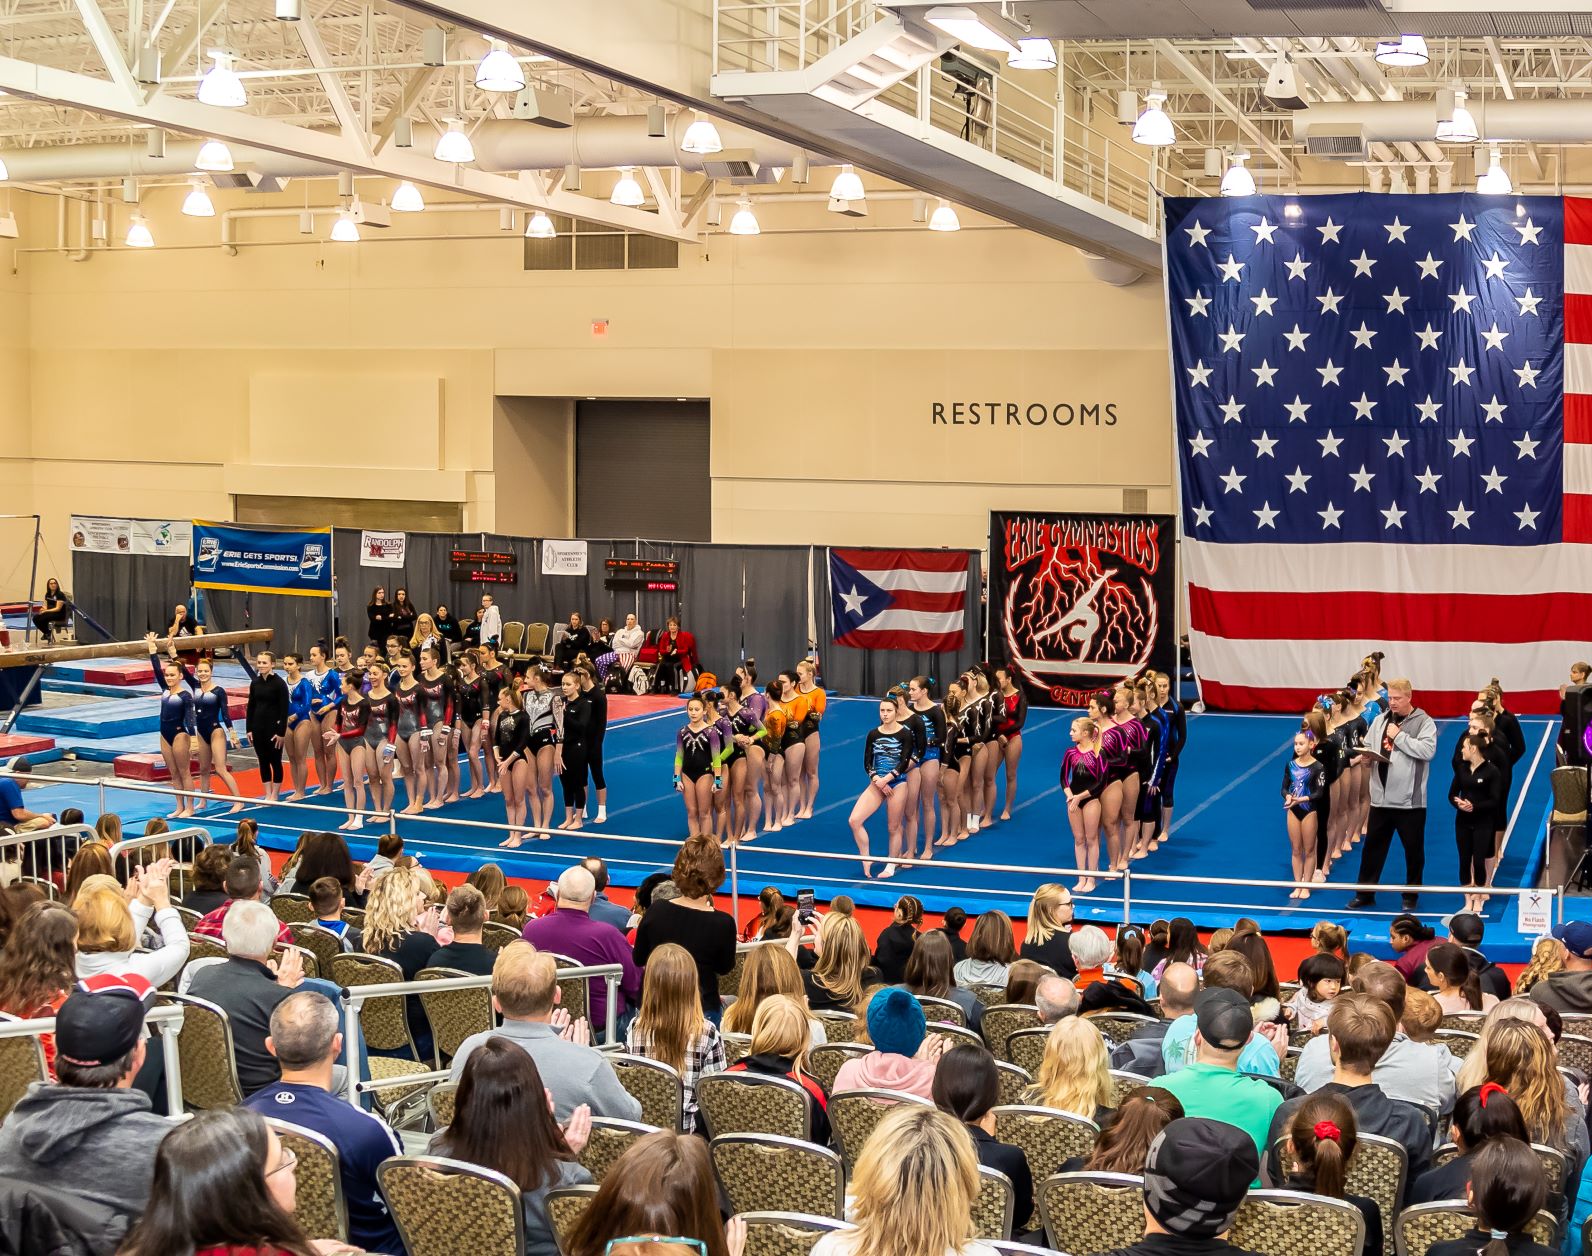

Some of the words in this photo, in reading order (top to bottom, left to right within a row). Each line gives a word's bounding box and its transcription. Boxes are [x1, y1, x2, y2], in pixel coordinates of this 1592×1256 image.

[932, 402, 1118, 426] RESTROOMS
[364, 535, 404, 548] RANDOLPH
[1008, 517, 1045, 568] ERIE
[1051, 519, 1157, 573] GYMNASTICS
[223, 551, 242, 559] ERIE
[243, 552, 263, 560] GETS
